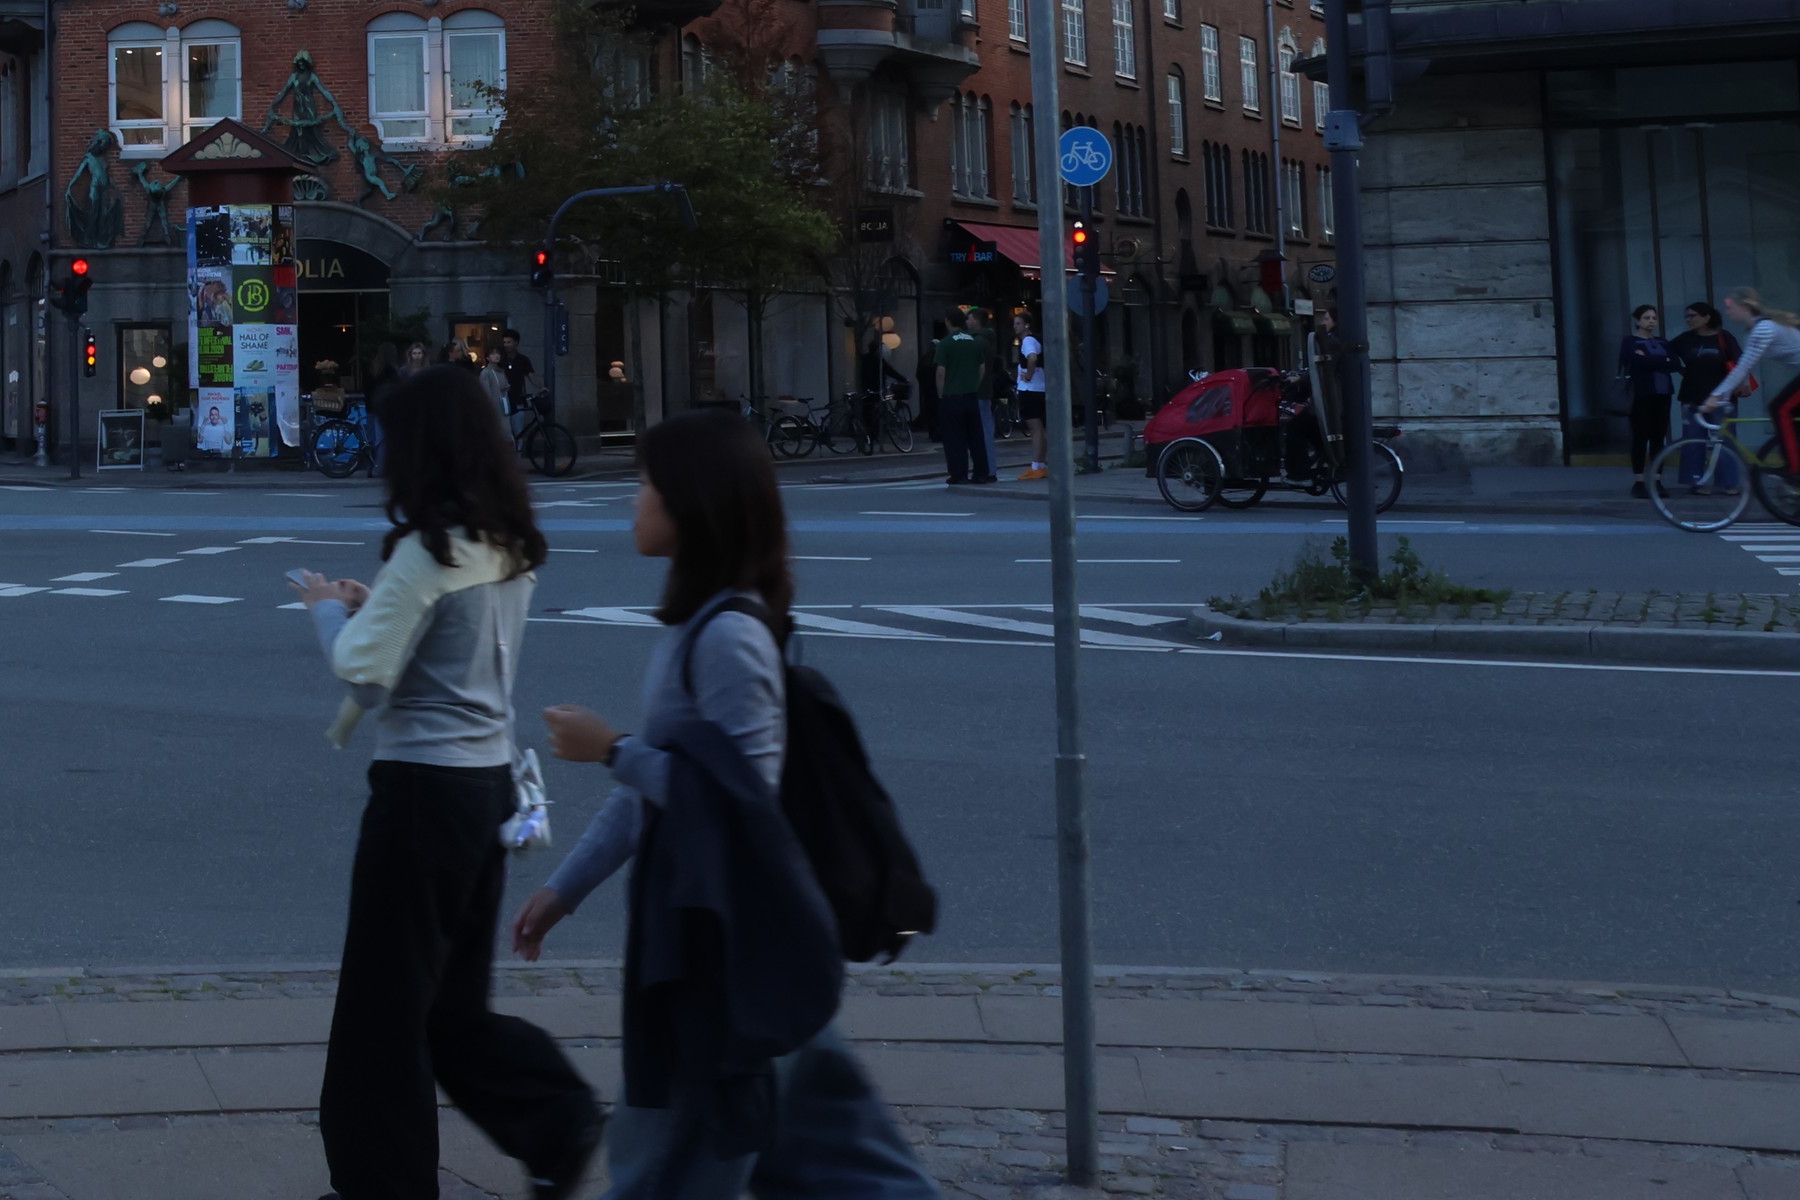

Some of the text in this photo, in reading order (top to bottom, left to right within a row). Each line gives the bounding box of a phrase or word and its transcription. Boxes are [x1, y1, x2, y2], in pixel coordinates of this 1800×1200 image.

[974, 252, 993, 261] BAR
[296, 258, 345, 278] LIA
[240, 333, 270, 341] HALL OF
[240, 342, 269, 350] SHAME
